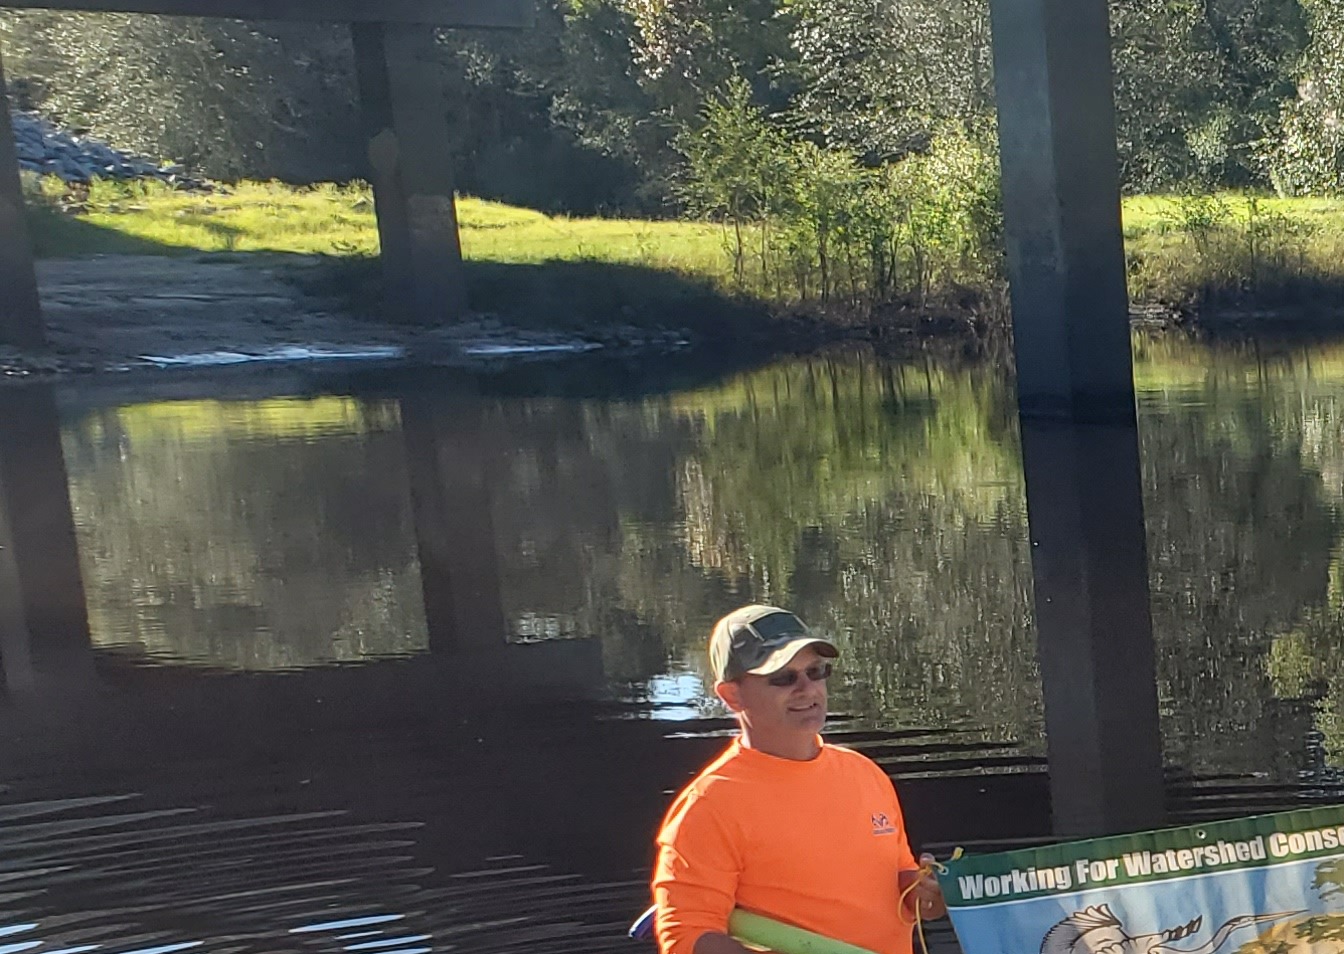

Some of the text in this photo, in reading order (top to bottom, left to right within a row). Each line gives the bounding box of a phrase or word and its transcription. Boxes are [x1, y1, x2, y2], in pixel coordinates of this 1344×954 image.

[958, 867, 1072, 900] Working
[1075, 858, 1119, 884] For
[1122, 836, 1266, 877] Watershed
